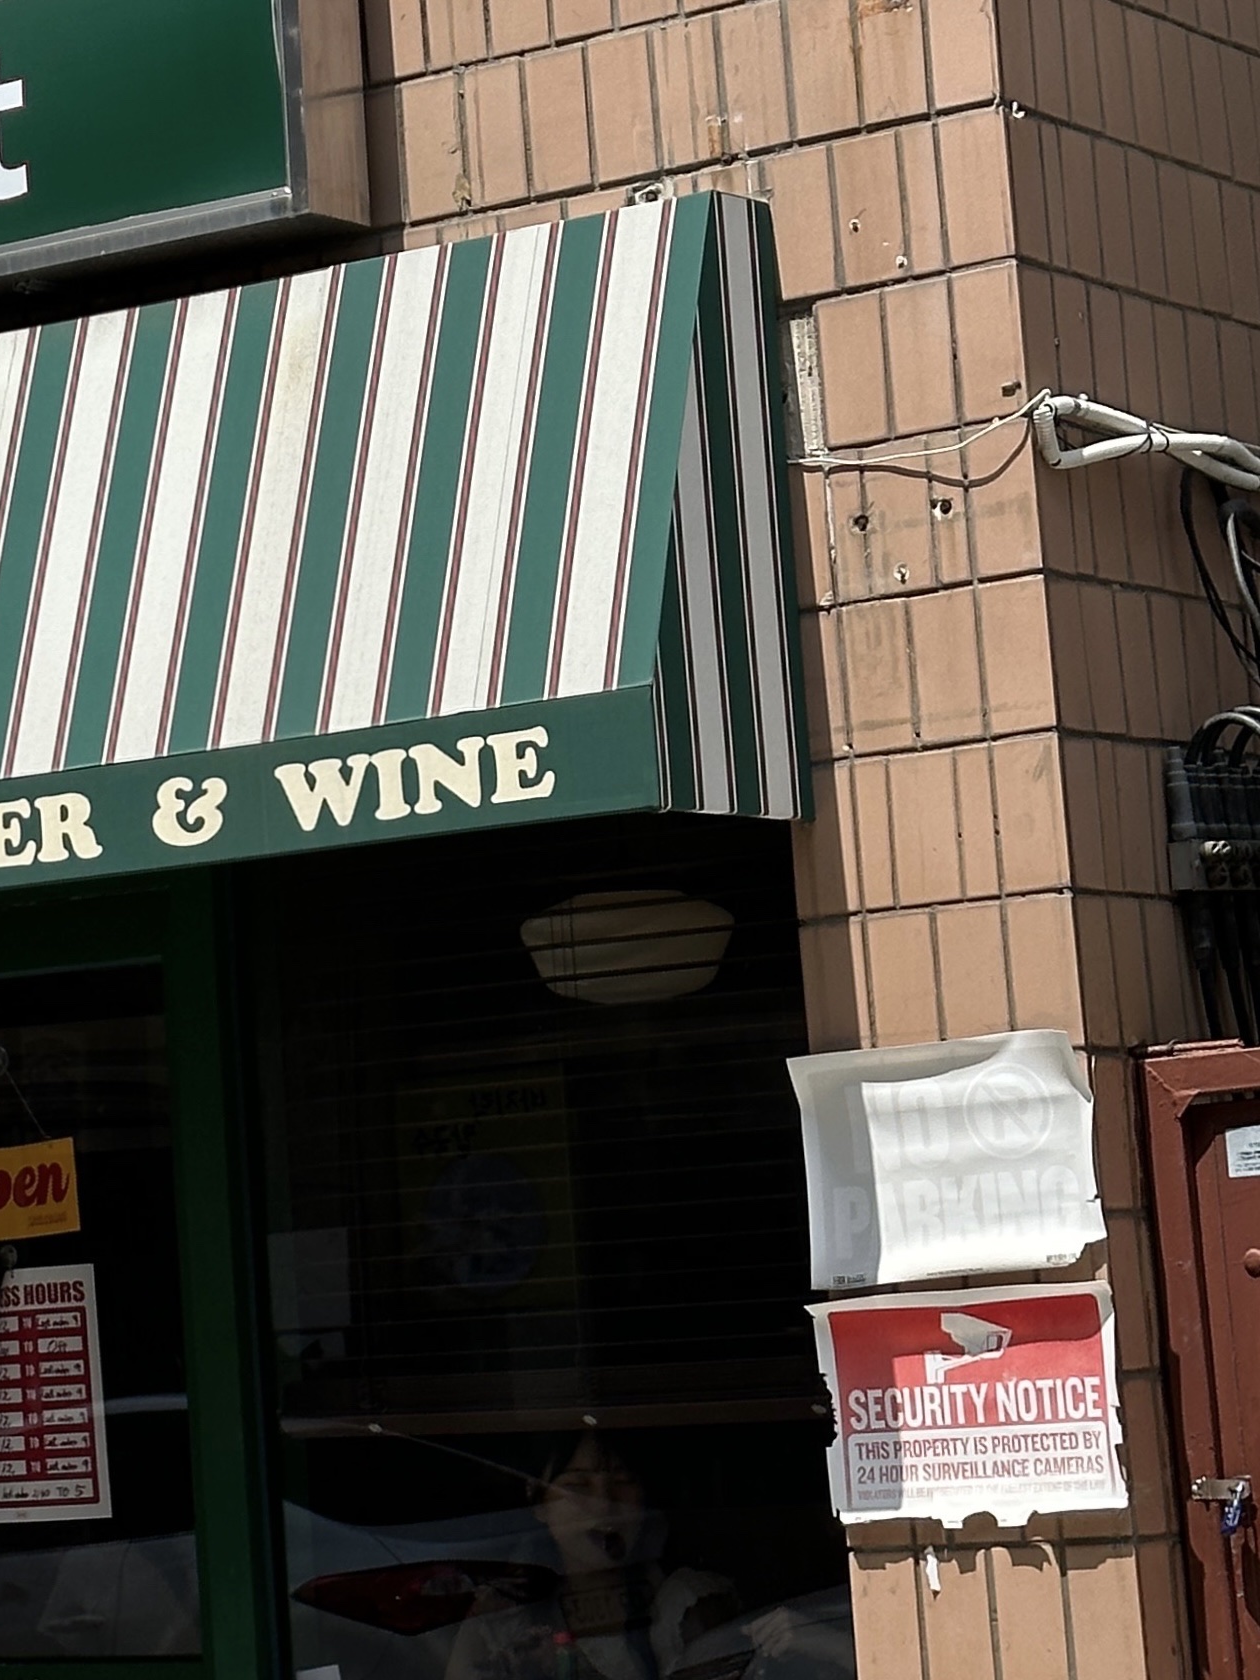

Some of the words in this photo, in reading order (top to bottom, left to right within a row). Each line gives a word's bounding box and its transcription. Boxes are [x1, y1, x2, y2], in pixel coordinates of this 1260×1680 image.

[151, 776, 228, 847] &
[273, 726, 556, 832] WINE
[843, 1080, 951, 1174] NO
[831, 1164, 1082, 1259] PARKING
[23, 1280, 86, 1306] HOURS
[849, 1383, 988, 1431] SECURITY
[997, 1376, 1104, 1423] NOTICE
[855, 1441, 890, 1461] THIS
[893, 1437, 972, 1459] PROPERTY
[973, 1436, 988, 1456] IS
[991, 1431, 1079, 1454] PROTECTED
[1083, 1430, 1103, 1450] BY
[857, 1465, 875, 1485] 24
[878, 1463, 919, 1484] HOUR
[922, 1458, 1030, 1482] SURVEILLANCE
[1033, 1455, 1105, 1477] CAMERAS
